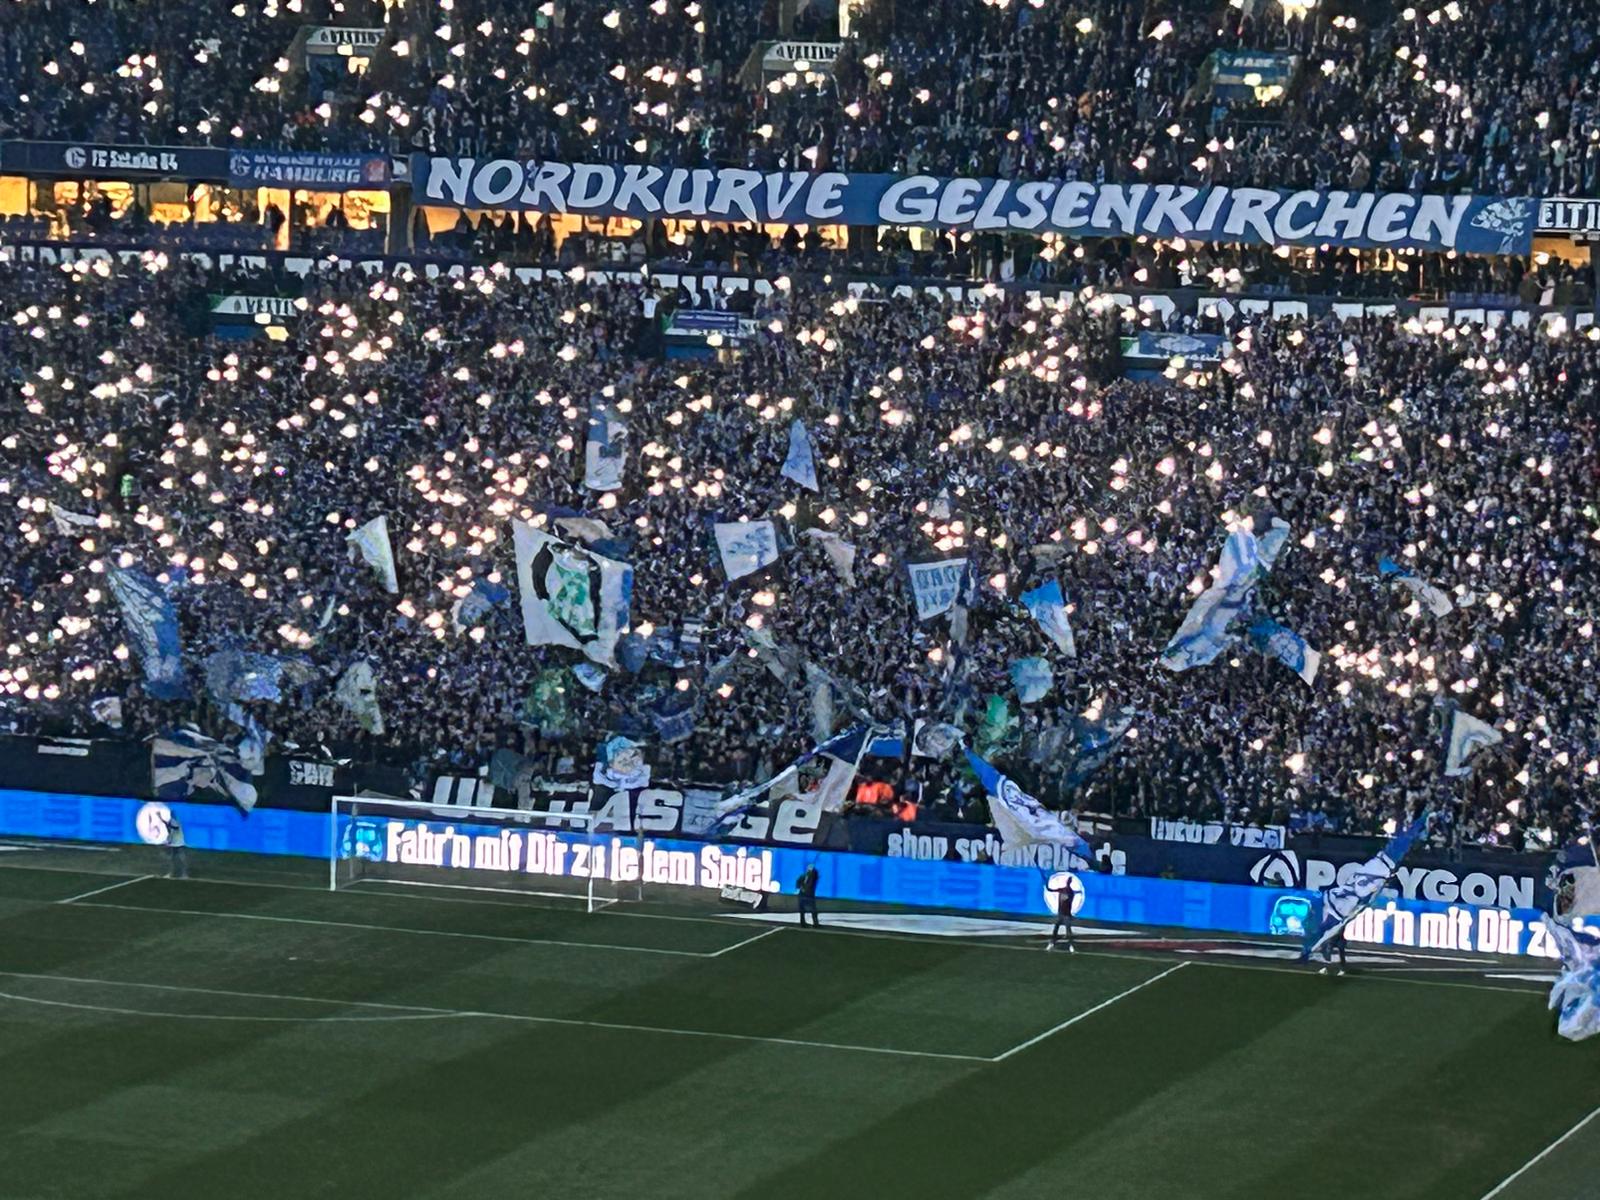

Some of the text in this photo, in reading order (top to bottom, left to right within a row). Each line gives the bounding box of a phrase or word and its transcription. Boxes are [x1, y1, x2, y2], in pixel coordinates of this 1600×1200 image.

[426, 157, 1471, 247] NORDKURVE GELSENKIRCHEN
[1538, 202, 1600, 230] ELTI
[386, 821, 471, 868] Fahr'n
[475, 829, 523, 871] mit
[526, 832, 568, 875] Dir
[701, 845, 780, 894] Spiel.
[1306, 860, 1534, 909] POYGON
[1420, 906, 1473, 950] mit
[1478, 909, 1524, 955] Dir
